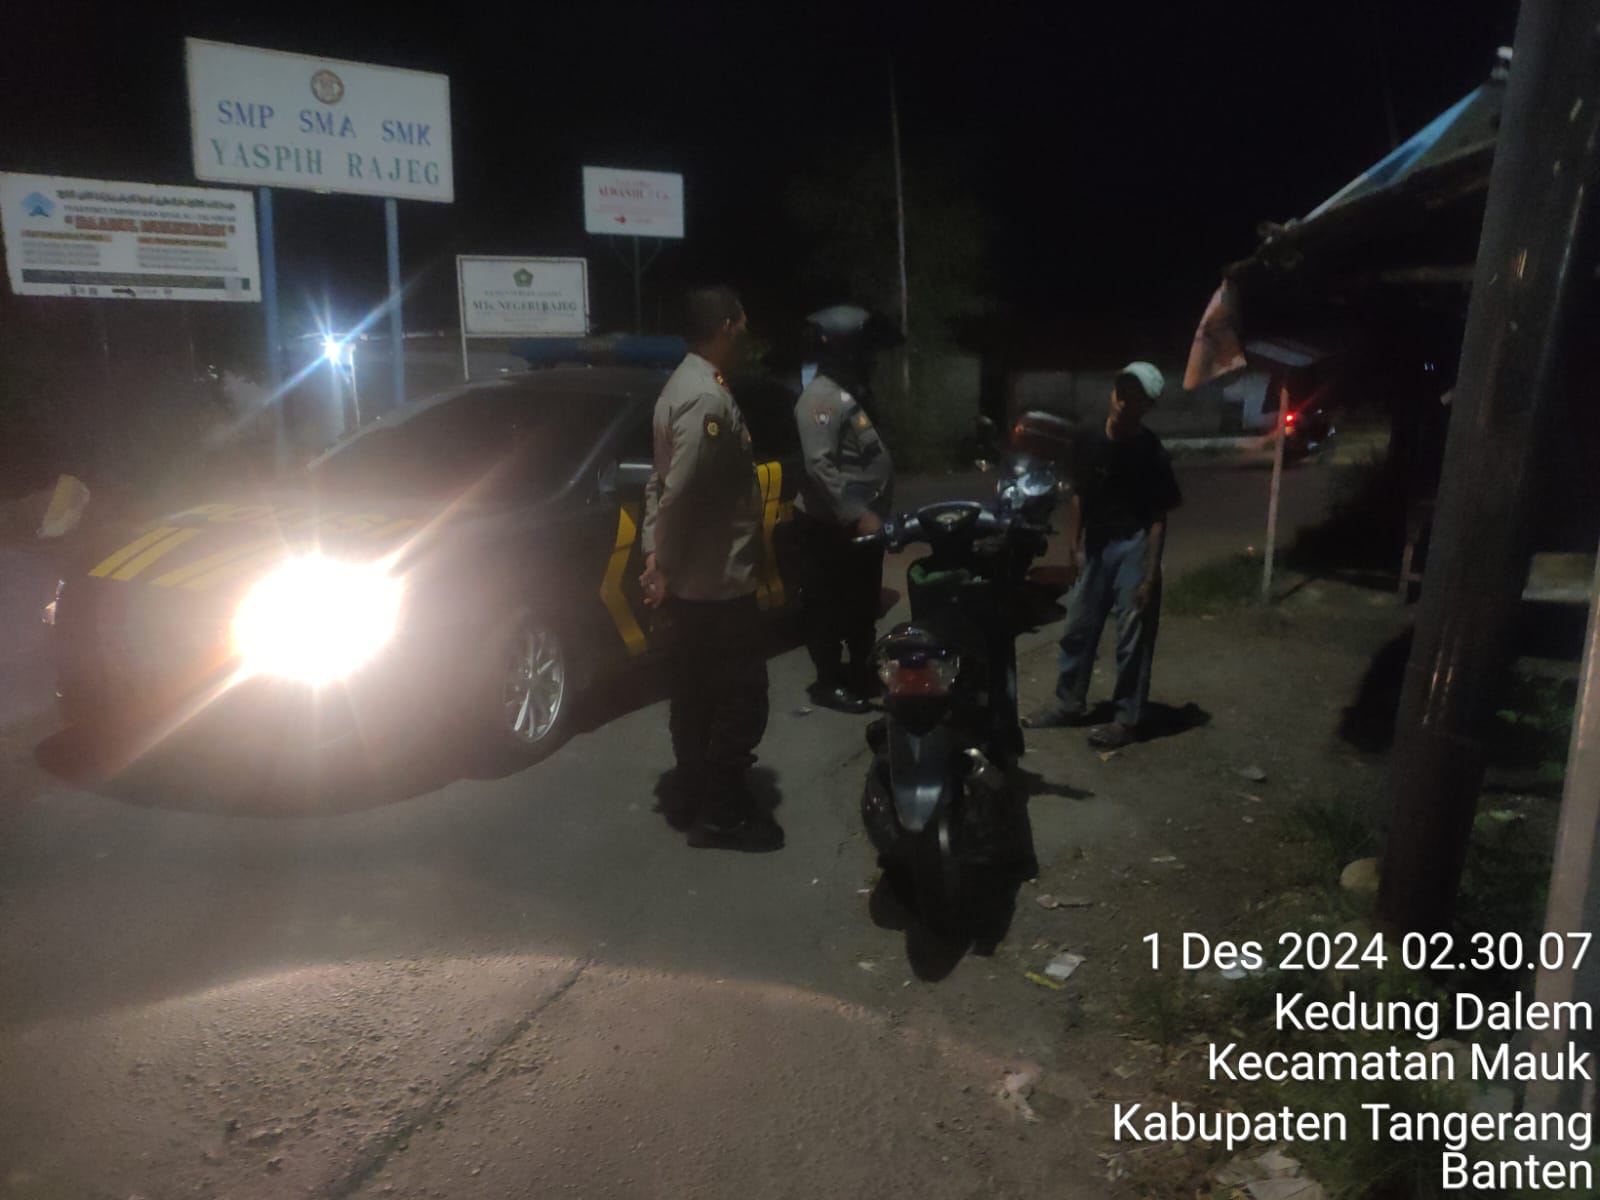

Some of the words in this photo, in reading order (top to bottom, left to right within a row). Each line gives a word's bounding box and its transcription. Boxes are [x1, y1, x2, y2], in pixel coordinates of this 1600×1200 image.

[218, 100, 275, 129] SMP
[299, 109, 357, 138] SMA
[381, 119, 432, 146] SMK
[210, 137, 324, 175] YASPIH
[347, 152, 440, 185] RAJEG
[542, 300, 577, 311] RAJEG
